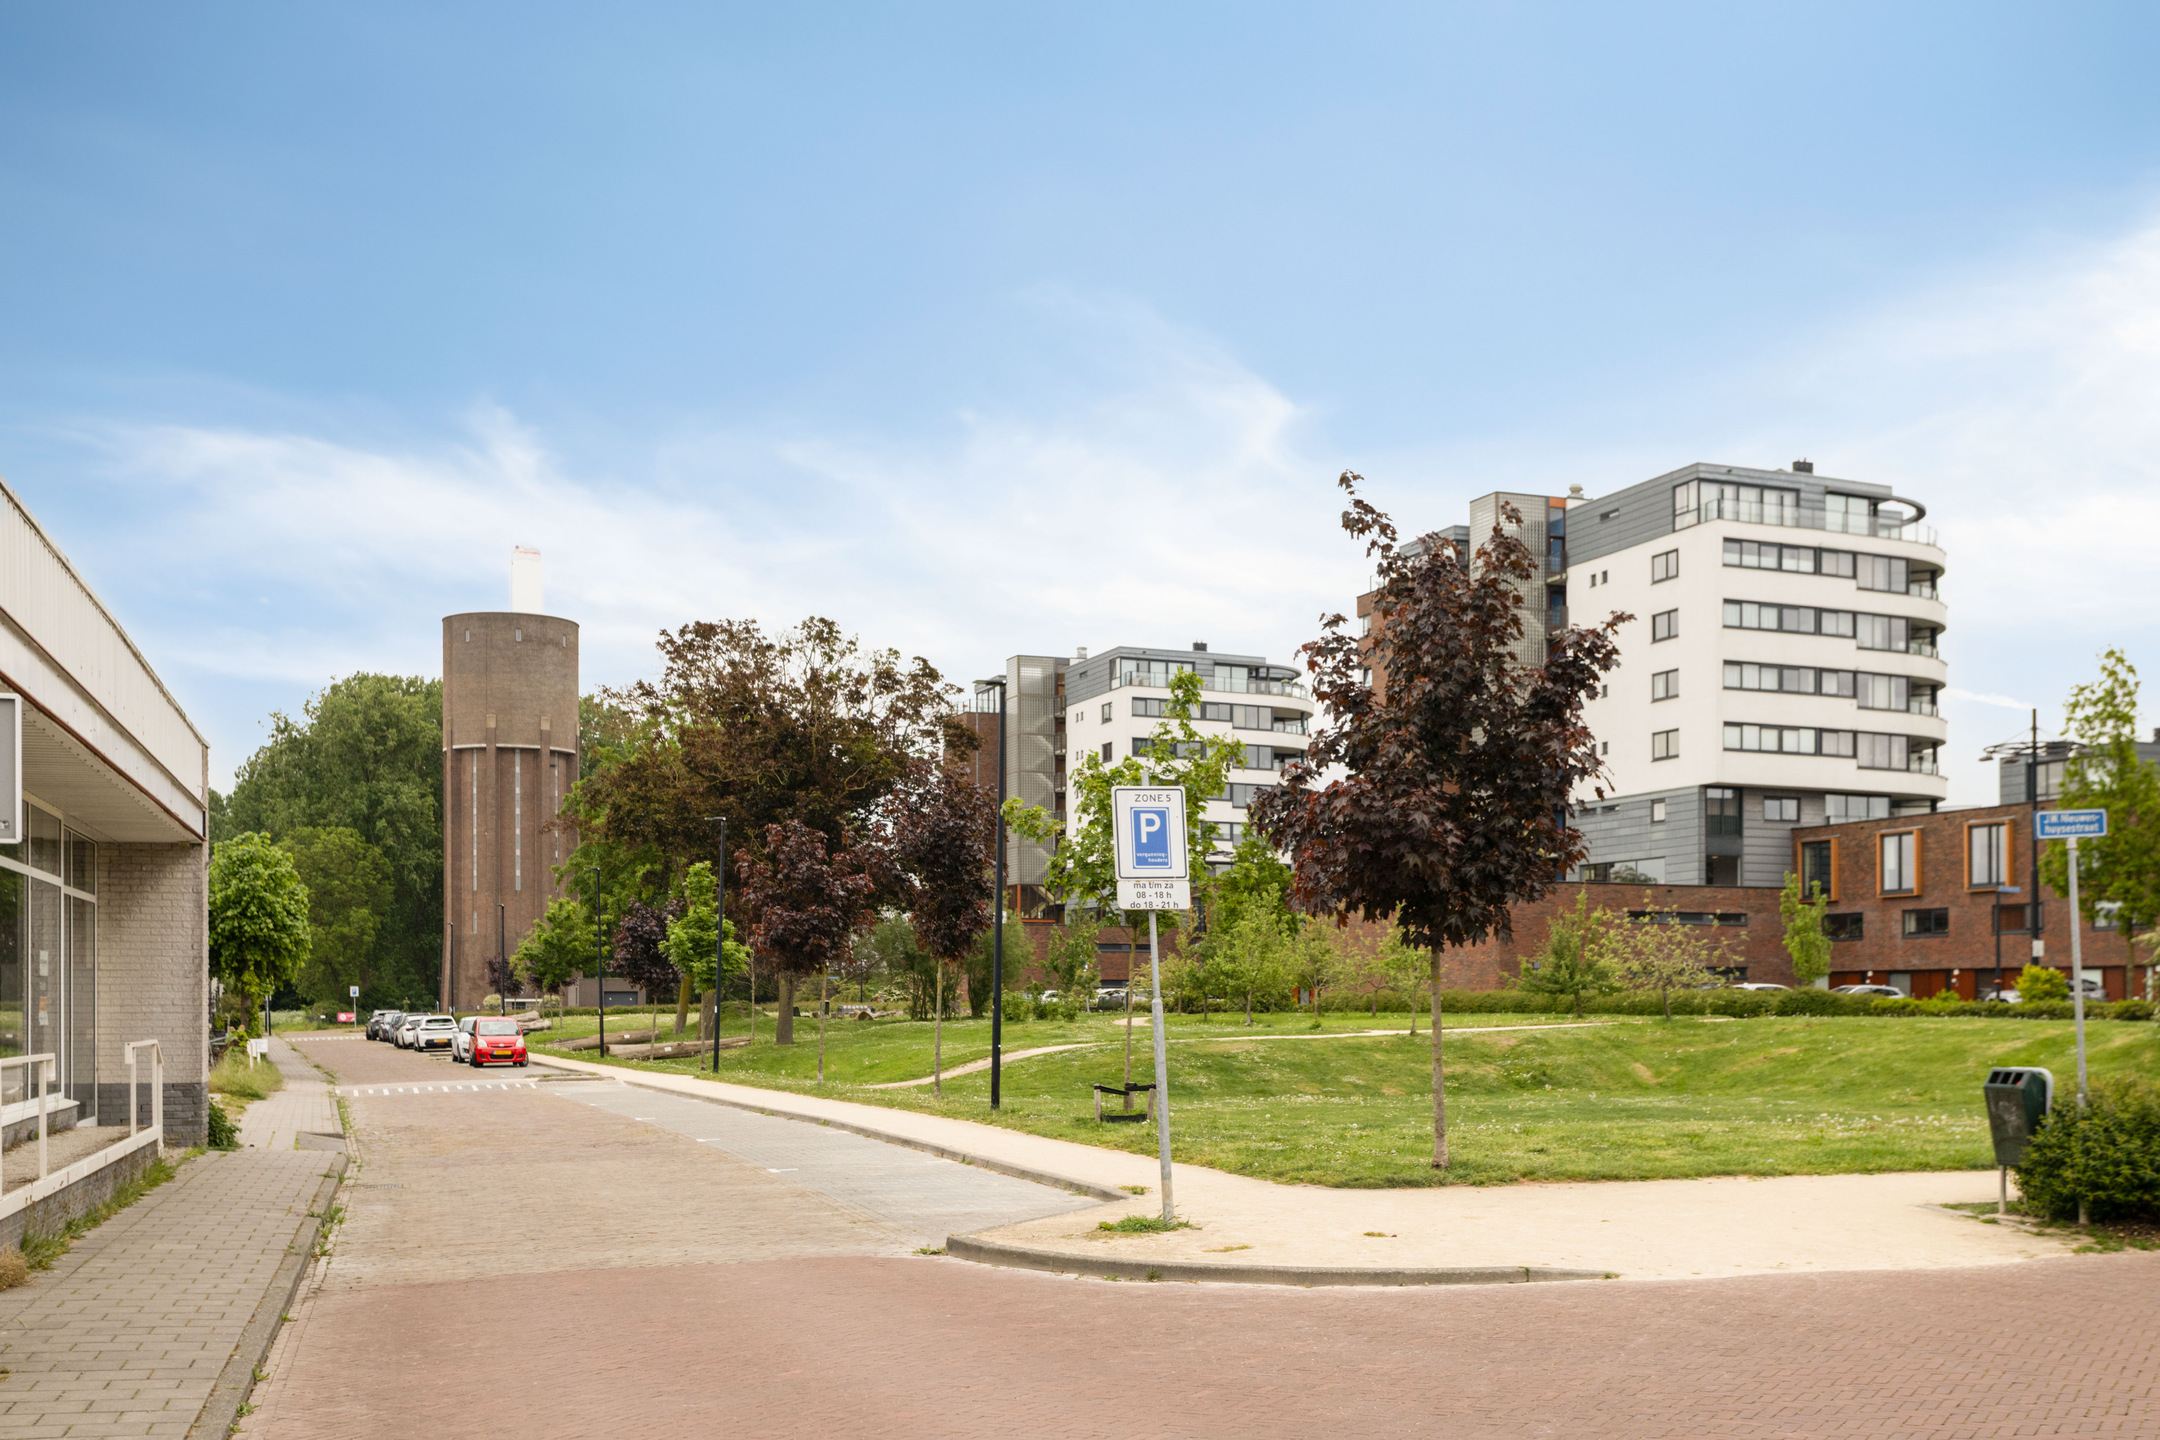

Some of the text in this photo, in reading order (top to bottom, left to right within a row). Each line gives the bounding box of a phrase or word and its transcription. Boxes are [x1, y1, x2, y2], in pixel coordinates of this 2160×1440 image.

[1134, 794, 1172, 802] ZONE 5
[1140, 812, 1160, 844] P
